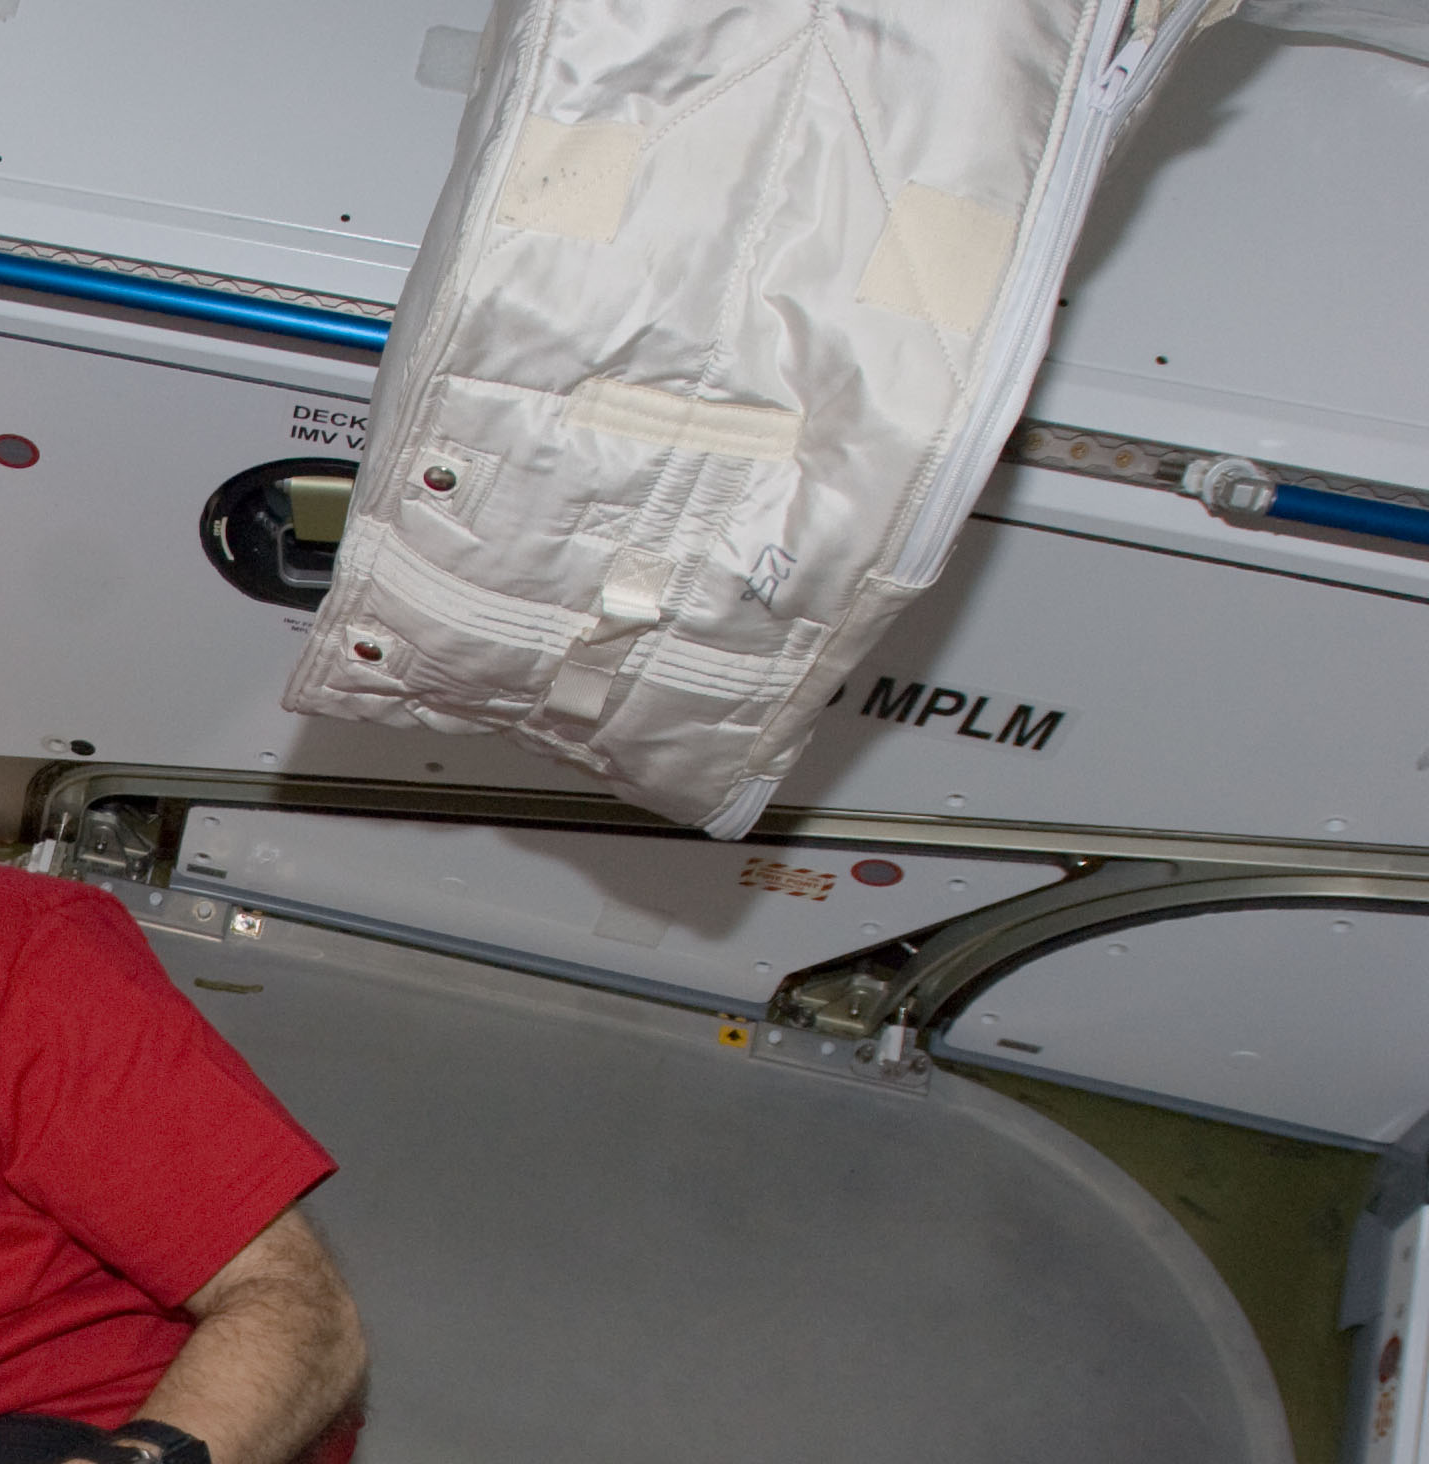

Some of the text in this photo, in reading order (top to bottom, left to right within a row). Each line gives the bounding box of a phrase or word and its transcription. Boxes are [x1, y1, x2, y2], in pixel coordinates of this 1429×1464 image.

[292, 405, 368, 431] DECK
[290, 425, 338, 446] IMV
[861, 676, 1065, 751] MPLM
